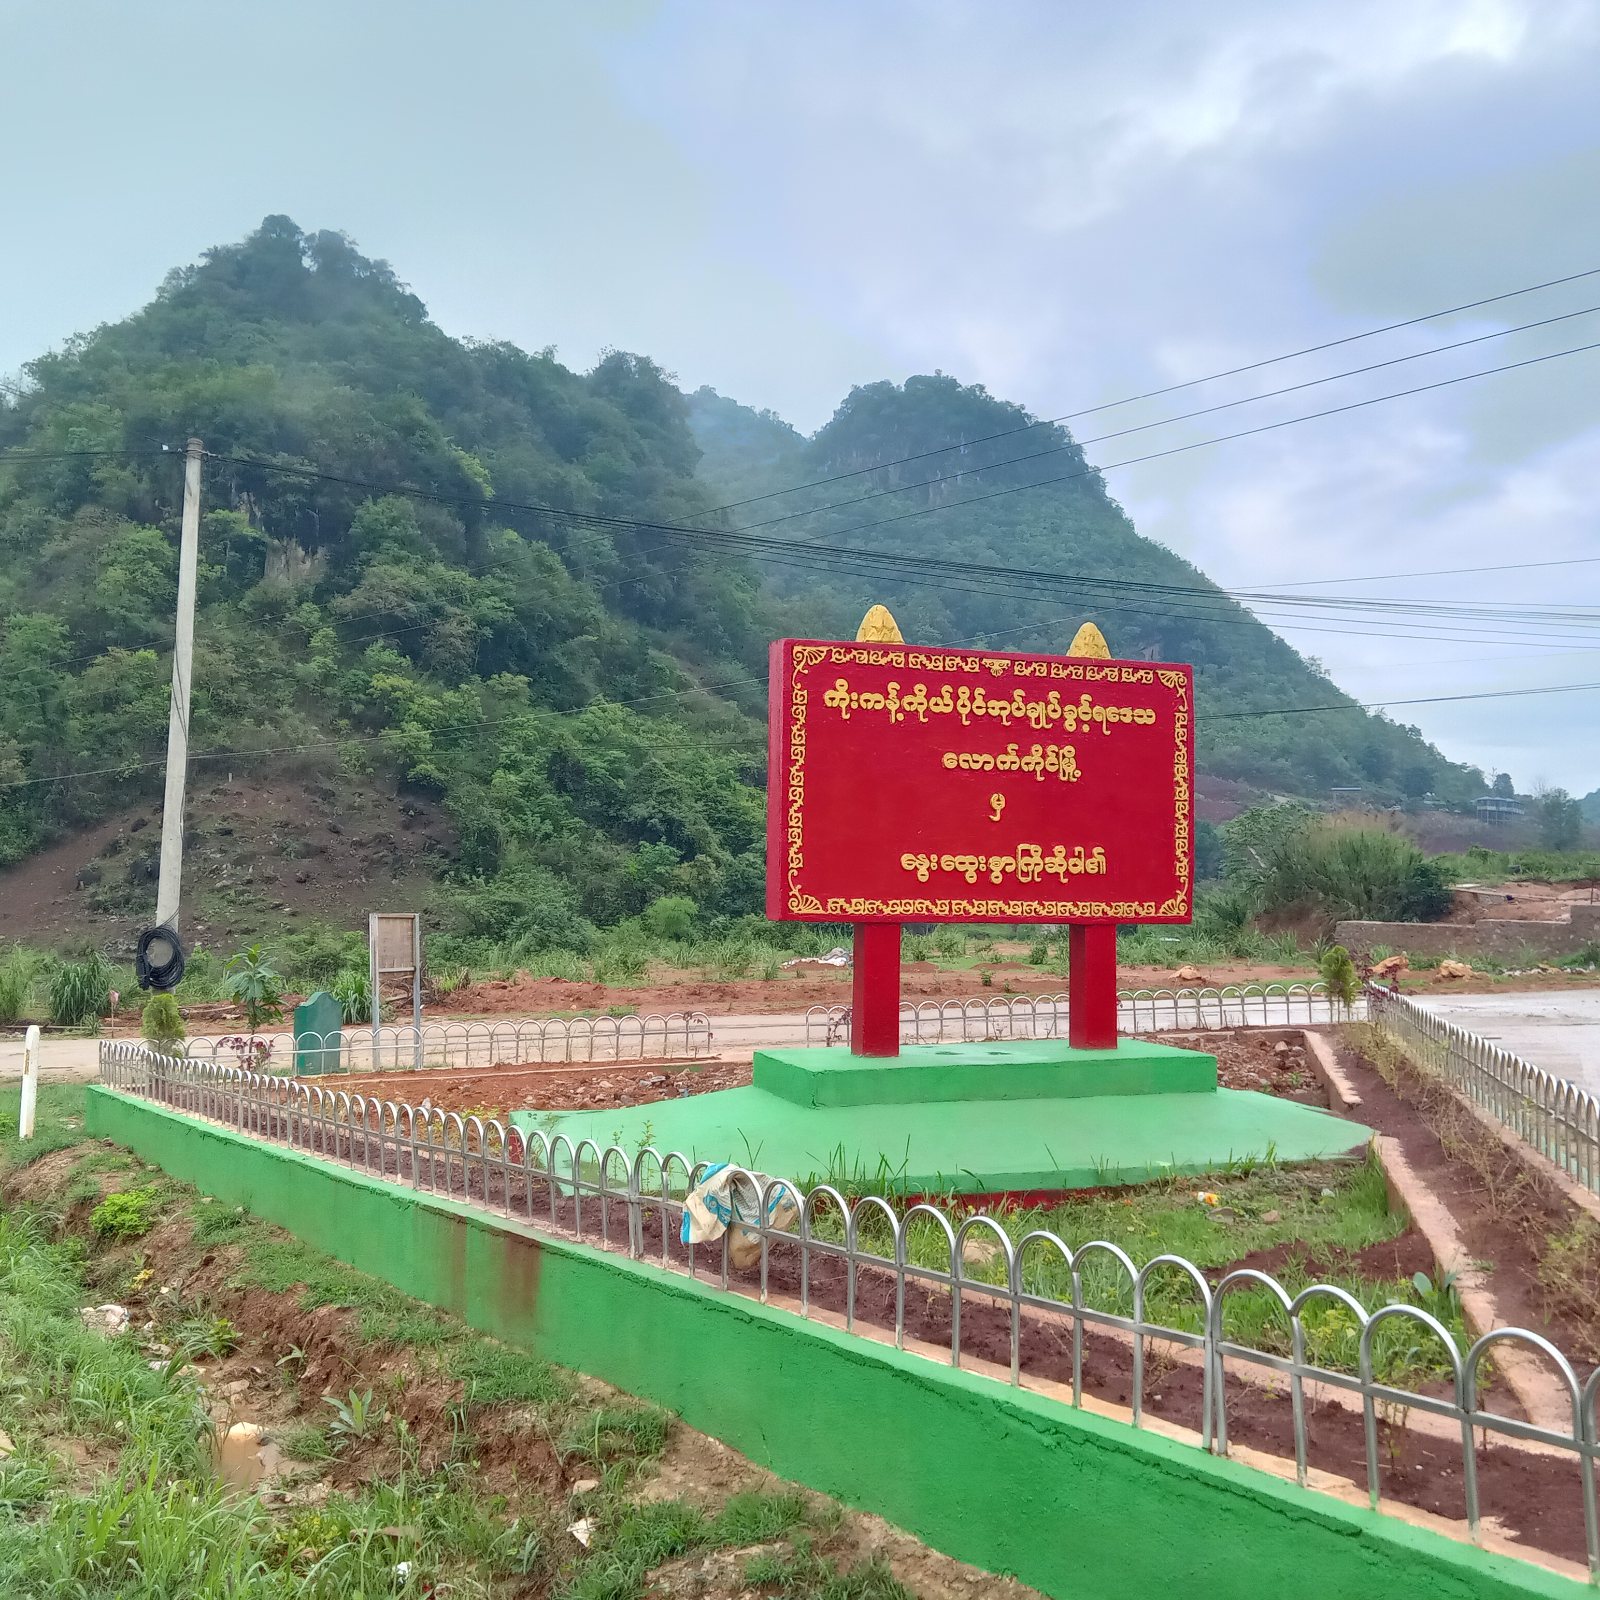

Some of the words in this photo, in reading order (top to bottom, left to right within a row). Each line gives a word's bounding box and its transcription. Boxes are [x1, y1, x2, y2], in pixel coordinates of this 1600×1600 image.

[942, 743, 1082, 782] လောက်ကိုင်မြို့
[989, 793, 1006, 822] မှ
